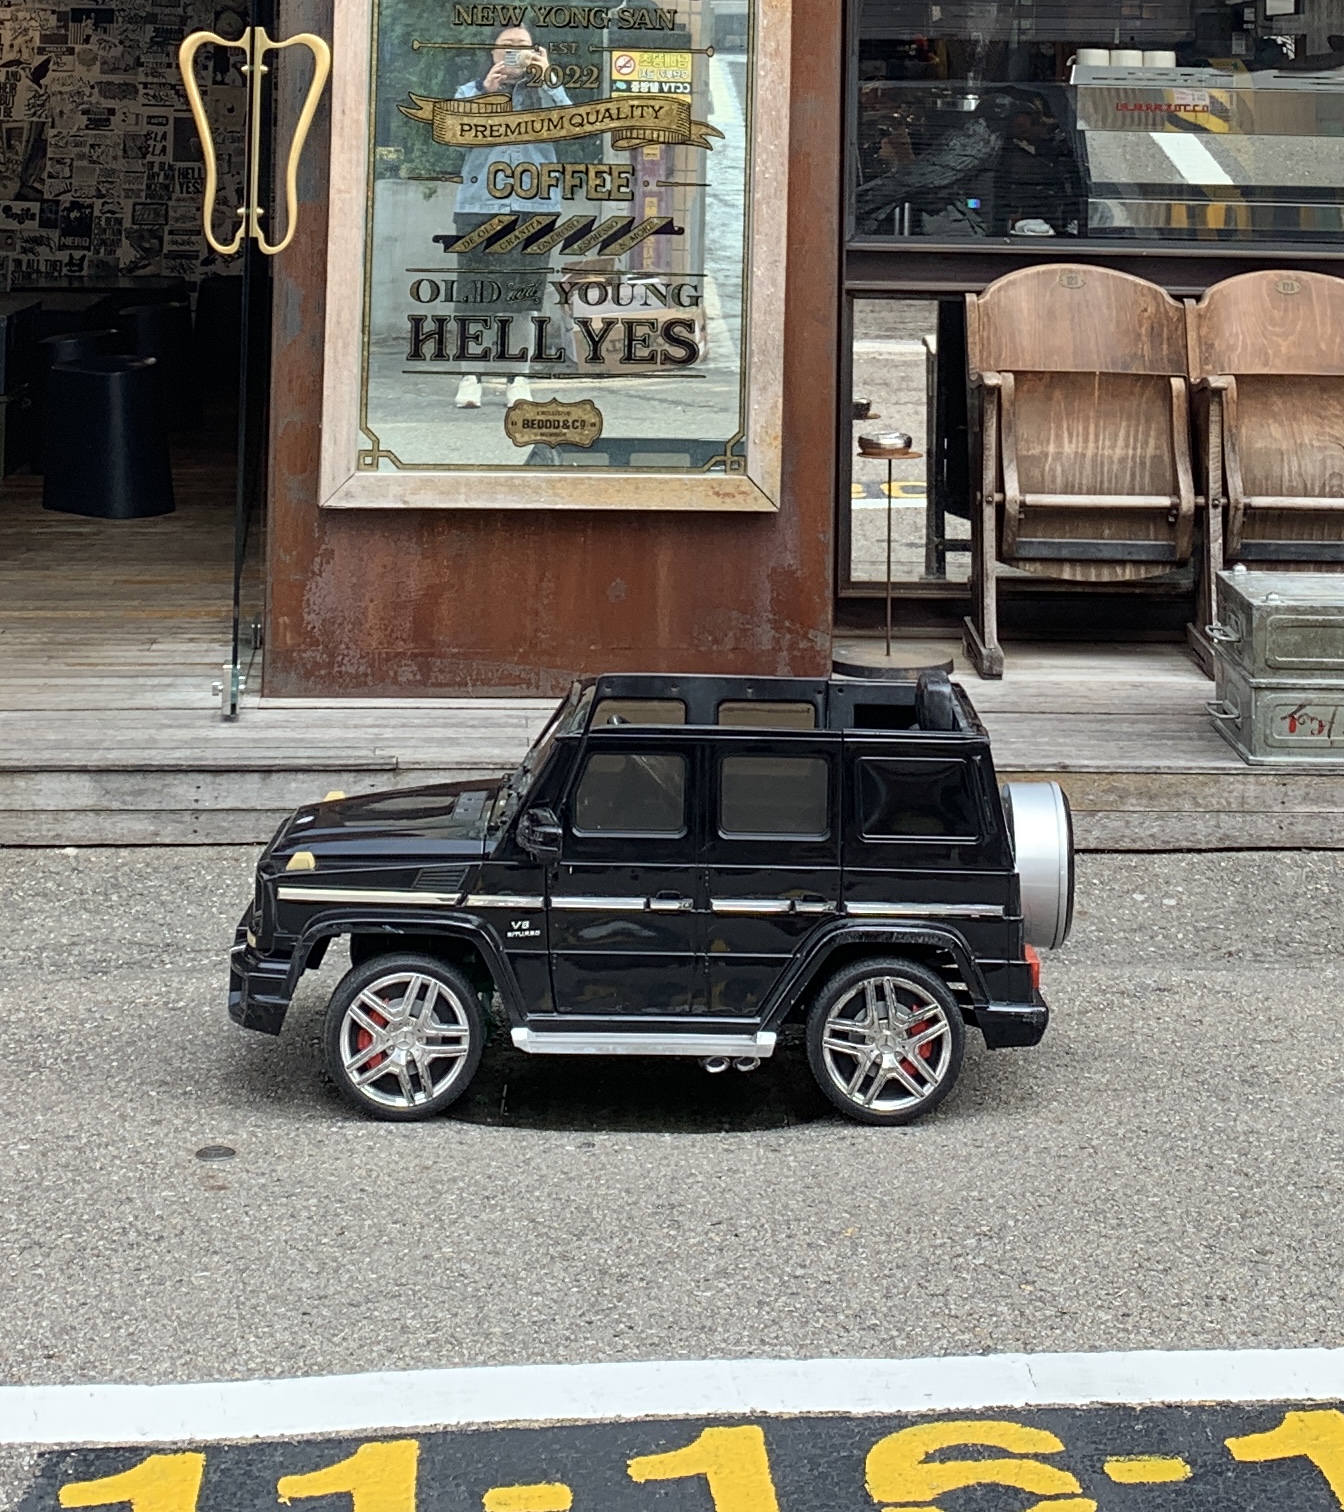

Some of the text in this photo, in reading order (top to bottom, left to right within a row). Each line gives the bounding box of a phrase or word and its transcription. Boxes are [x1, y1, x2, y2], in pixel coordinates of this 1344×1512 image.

[453, 4, 677, 30] NEW YONG SAN
[549, 41, 580, 55] EST
[526, 64, 600, 89] 2022
[459, 104, 665, 138] PREMIUM QUALITY
[487, 161, 634, 201] COFFEE
[462, 218, 505, 250] DE OLLA
[498, 218, 544, 251] GRANITA
[576, 219, 619, 252] ESPRESSO
[409, 279, 502, 304] OLD
[548, 281, 704, 308] YOUNG
[406, 314, 565, 363] HELL
[574, 316, 699, 366] YES
